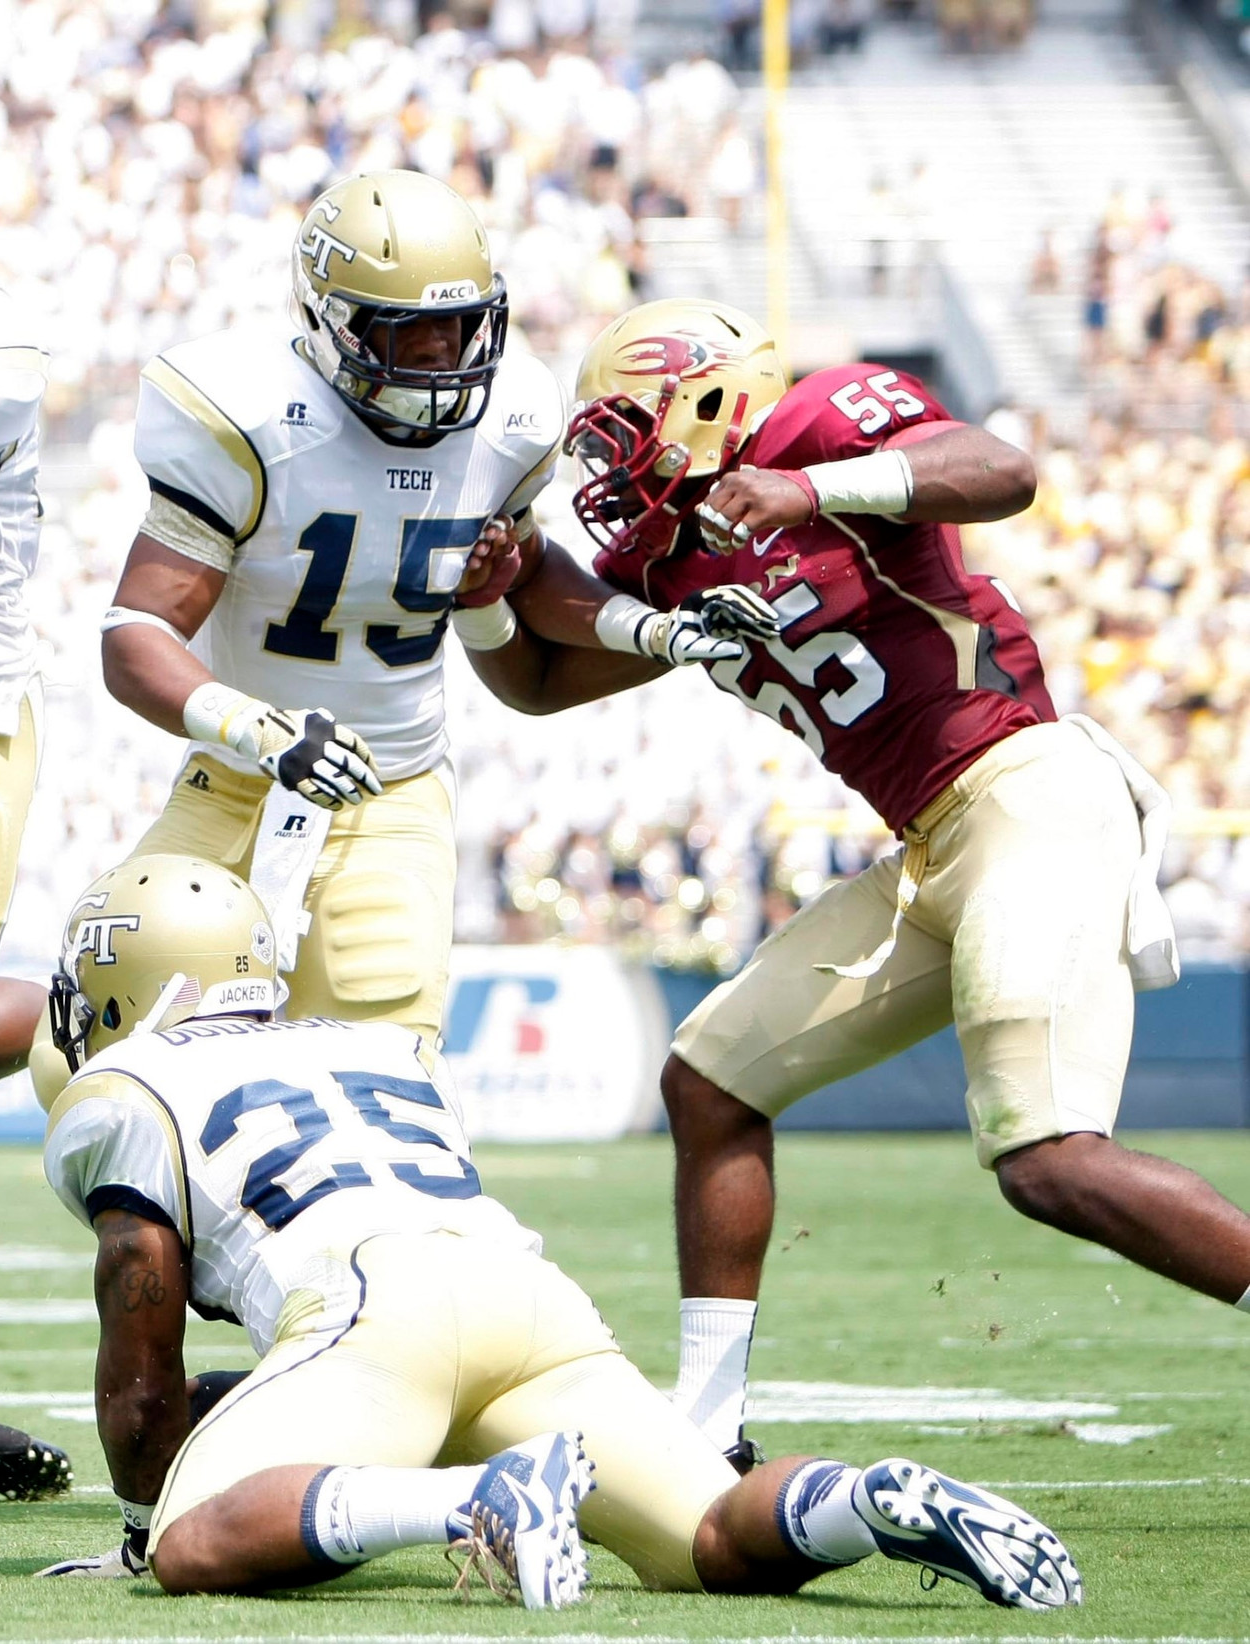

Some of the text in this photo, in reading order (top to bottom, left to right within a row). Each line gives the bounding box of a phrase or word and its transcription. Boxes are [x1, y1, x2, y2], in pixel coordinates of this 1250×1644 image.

[439, 287, 466, 300] ACC
[829, 369, 926, 436] 55
[506, 413, 541, 428] ACC
[387, 468, 435, 490] TECH
[262, 510, 492, 670] 15
[707, 578, 888, 765] 55
[235, 955, 249, 973] 25
[219, 985, 267, 1005] JACKETS
[197, 1071, 482, 1233] 25
